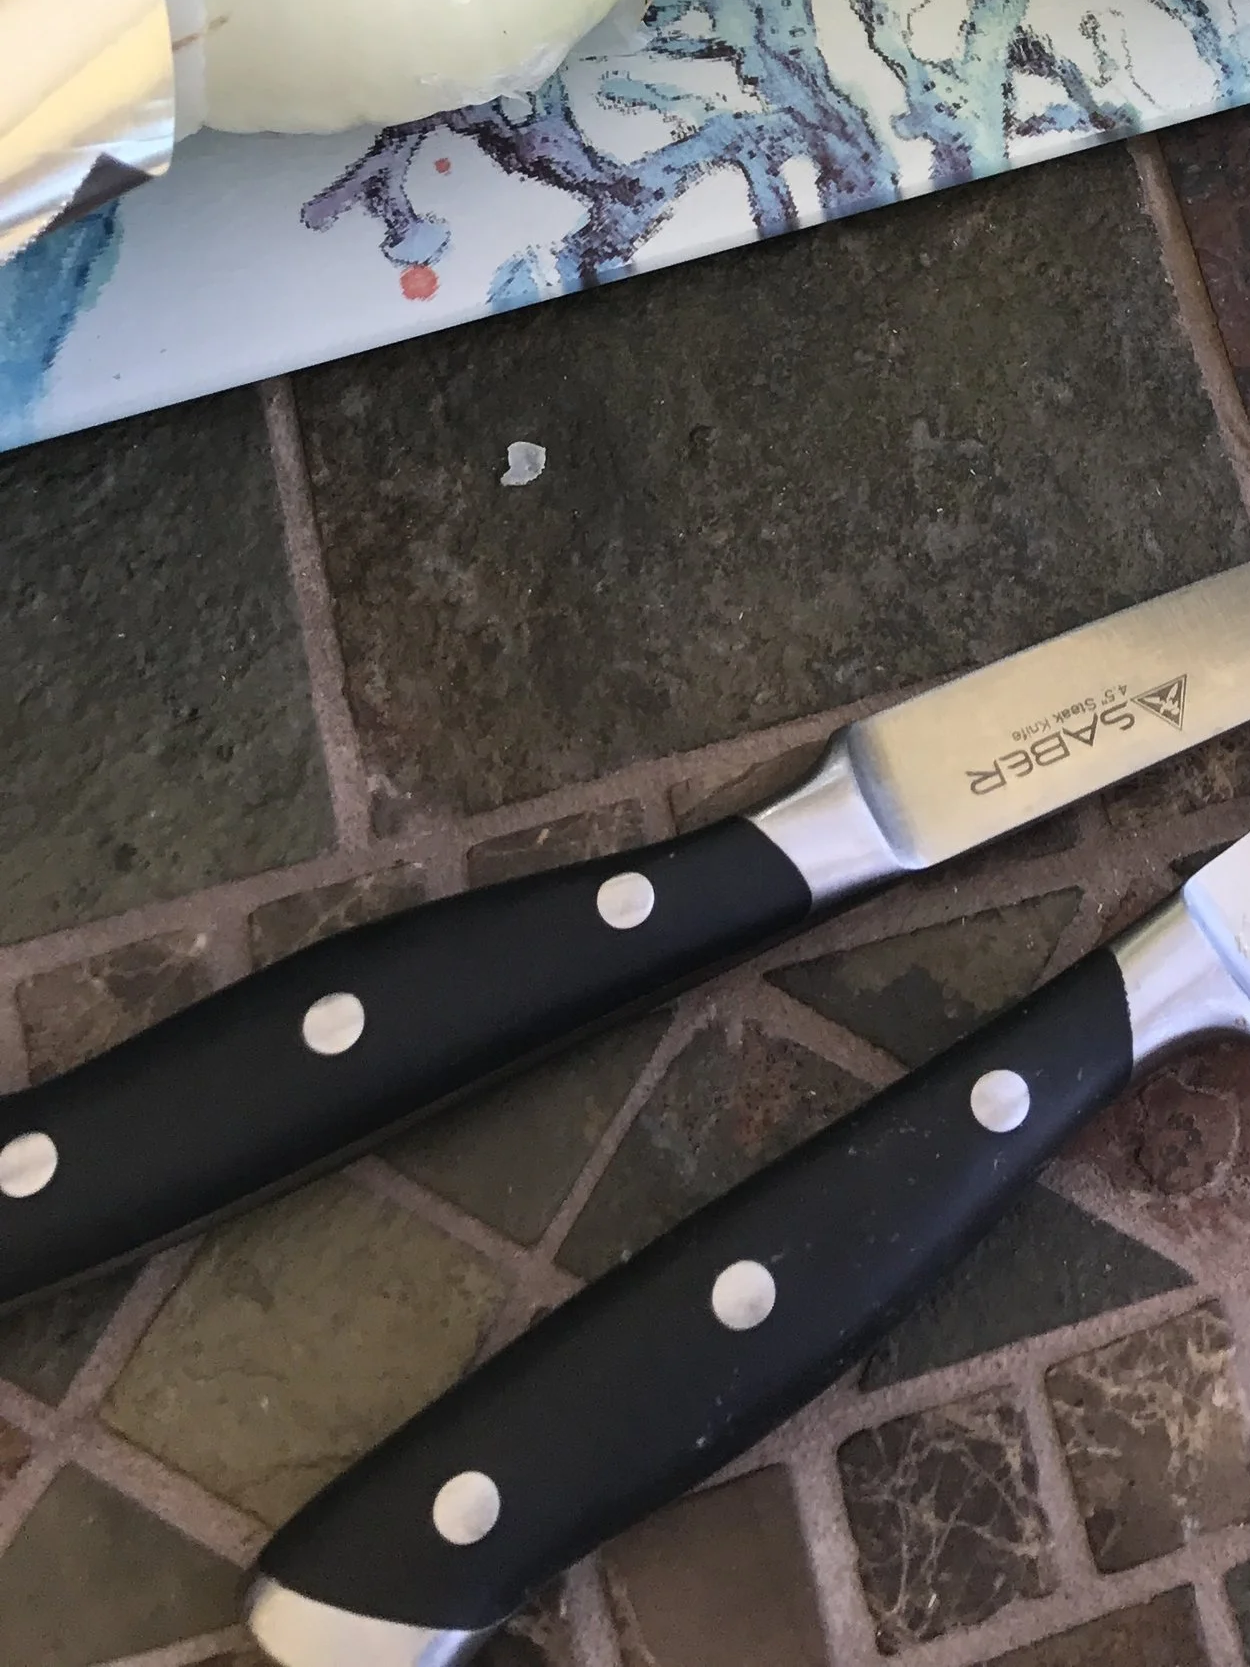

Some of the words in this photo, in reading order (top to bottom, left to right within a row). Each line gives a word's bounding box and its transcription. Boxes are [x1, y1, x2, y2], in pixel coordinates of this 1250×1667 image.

[1052, 697, 1097, 724] Steak
[1011, 717, 1052, 742] Knife
[965, 700, 1135, 795] SABER
